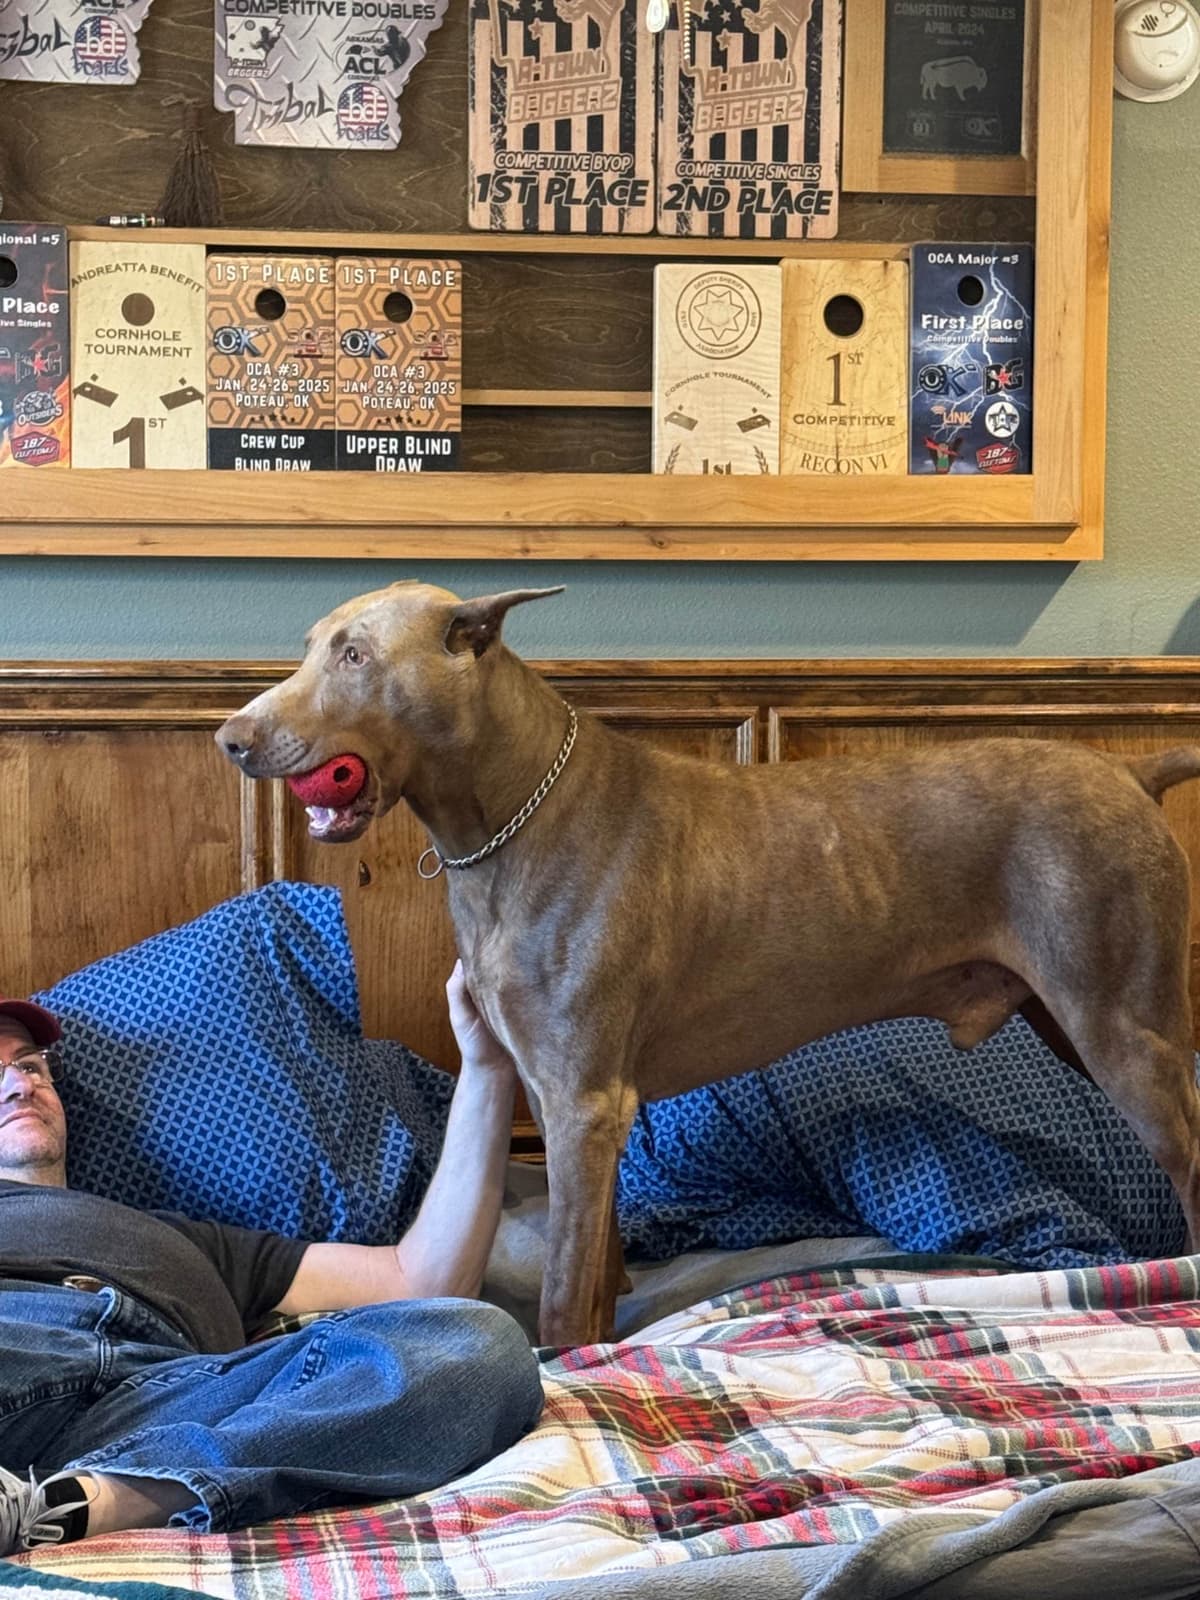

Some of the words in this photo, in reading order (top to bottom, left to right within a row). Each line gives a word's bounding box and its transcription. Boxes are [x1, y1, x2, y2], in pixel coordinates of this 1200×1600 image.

[224, 0, 346, 15] COMPETITIVE
[352, 2, 436, 19] DOUBLES
[894, 2, 967, 18] COMPETITIVE
[969, 6, 1017, 20] SINGLES
[924, 20, 955, 34] APRIL
[957, 23, 985, 36] 2024
[344, 56, 387, 75] ACL
[495, 152, 592, 171] COMPETITIVE
[593, 155, 633, 172] BYOP
[676, 162, 765, 179] COMPETITIVE
[767, 164, 821, 181] SINGLES
[477, 173, 537, 204] 1ST
[544, 177, 650, 207] PLACE
[663, 183, 731, 212] 2ND
[737, 188, 833, 216] PLACE
[0, 233, 37, 246] ional
[927, 252, 954, 265] OCA
[957, 253, 999, 266] Major
[72, 262, 148, 289] ANDREATTA
[150, 264, 204, 294] BENEFIT
[215, 263, 250, 282] 1ST
[262, 264, 330, 284] PLACE
[343, 266, 378, 285] 1ST
[390, 267, 456, 287] PLACE
[3, 297, 60, 314] Place
[921, 314, 967, 330] First
[972, 315, 1024, 330] Place
[95, 328, 182, 342] CORNHOLE
[84, 343, 193, 359] TOURNAMENT
[246, 363, 272, 376] OCA
[278, 364, 300, 377] #3
[373, 365, 398, 378] OCA
[404, 366, 426, 379] #3
[298, 379, 330, 393] 2025
[424, 381, 456, 395] 2025
[664, 371, 711, 398] CORNHOLE
[712, 371, 772, 399] TOURNAMENT
[294, 395, 310, 408] OK
[420, 397, 436, 410] OK
[793, 414, 896, 427] COMPETITIVE
[22, 437, 47, 450] 187
[240, 433, 277, 450] CREW
[281, 434, 306, 450] CUP
[346, 435, 399, 455] UPPER
[405, 436, 452, 456] BLIND
[985, 447, 1009, 460] 187
[235, 457, 271, 471] BLIND
[275, 457, 312, 471] DRAW
[375, 456, 423, 473] DRAW
[799, 452, 863, 475] RECON
[868, 453, 889, 471] VI
